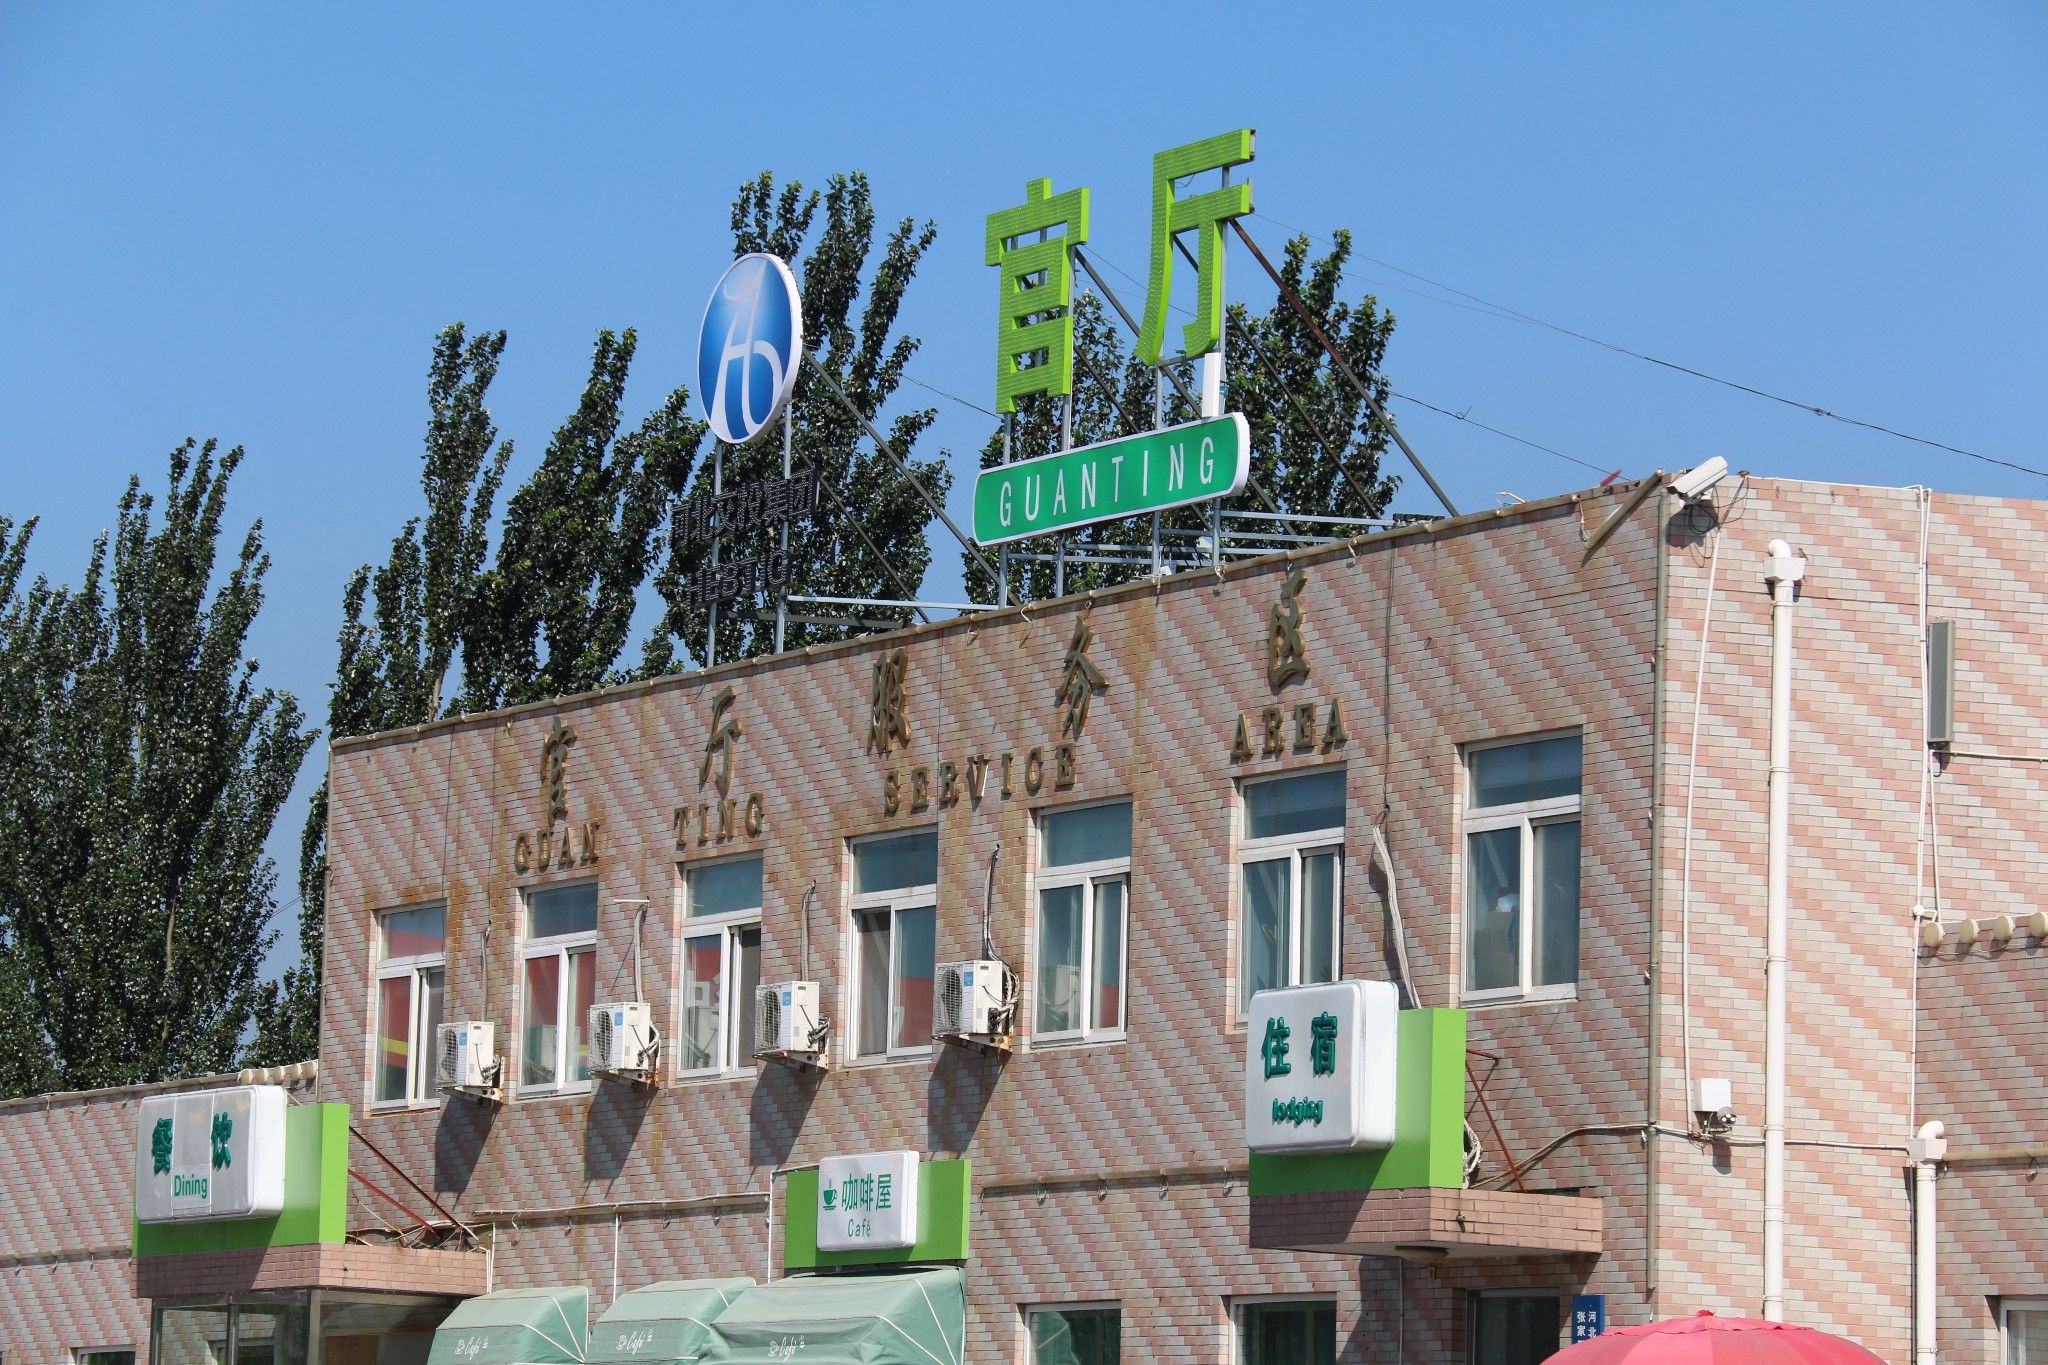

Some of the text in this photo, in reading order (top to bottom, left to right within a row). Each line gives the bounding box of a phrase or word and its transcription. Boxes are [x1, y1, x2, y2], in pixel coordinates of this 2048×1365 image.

[985, 128, 1256, 415] 官厅
[999, 436, 1215, 527] GUANTING
[513, 698, 1350, 873] GUAN TING SERVICE AREA
[1261, 1011, 1338, 1079] 住宿
[1272, 1096, 1324, 1125] lodging
[151, 1111, 233, 1176] 餐饮
[173, 1173, 208, 1199] Dining
[841, 1173, 892, 1212] 咖啡屋
[847, 1218, 872, 1238] Café
[1576, 1311, 1586, 1343] 张家
